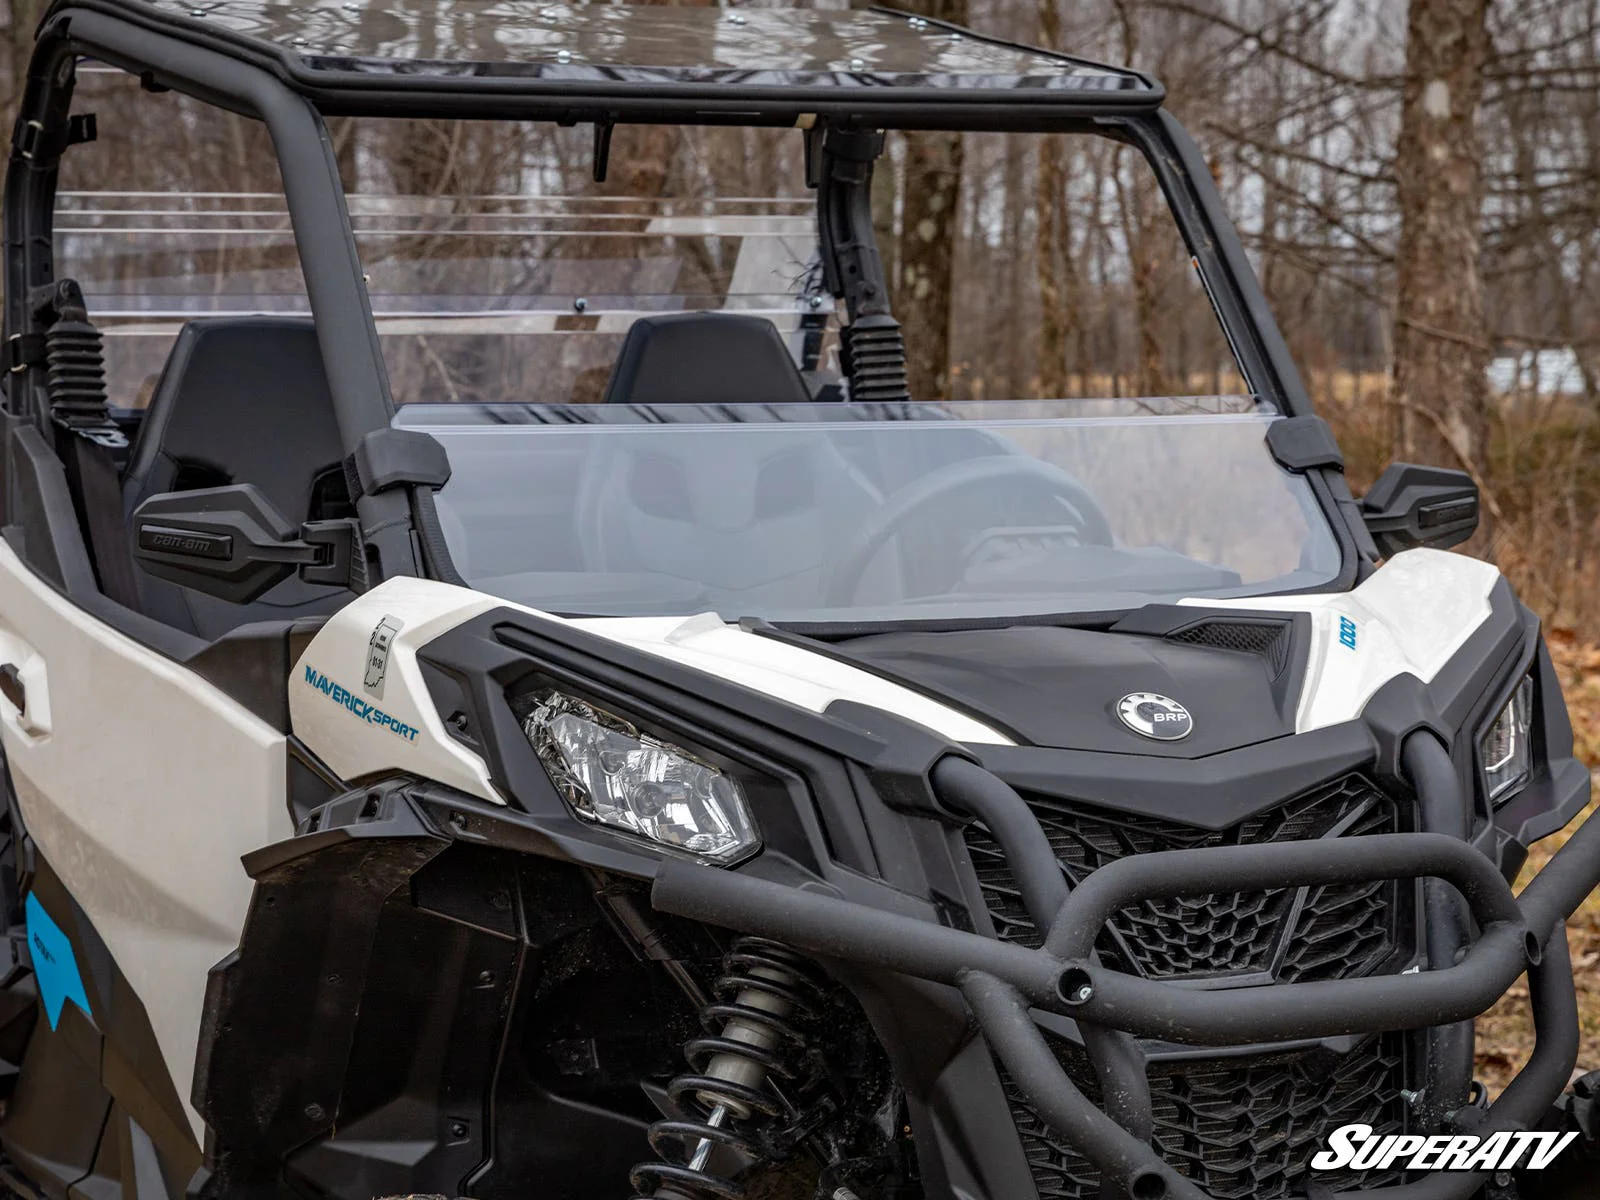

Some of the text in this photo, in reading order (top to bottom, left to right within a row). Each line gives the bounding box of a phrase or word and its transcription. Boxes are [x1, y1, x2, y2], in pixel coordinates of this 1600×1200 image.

[1339, 615, 1356, 651] 1000
[305, 664, 419, 741] MAVERICK SPORT
[1153, 712, 1187, 723] BRP
